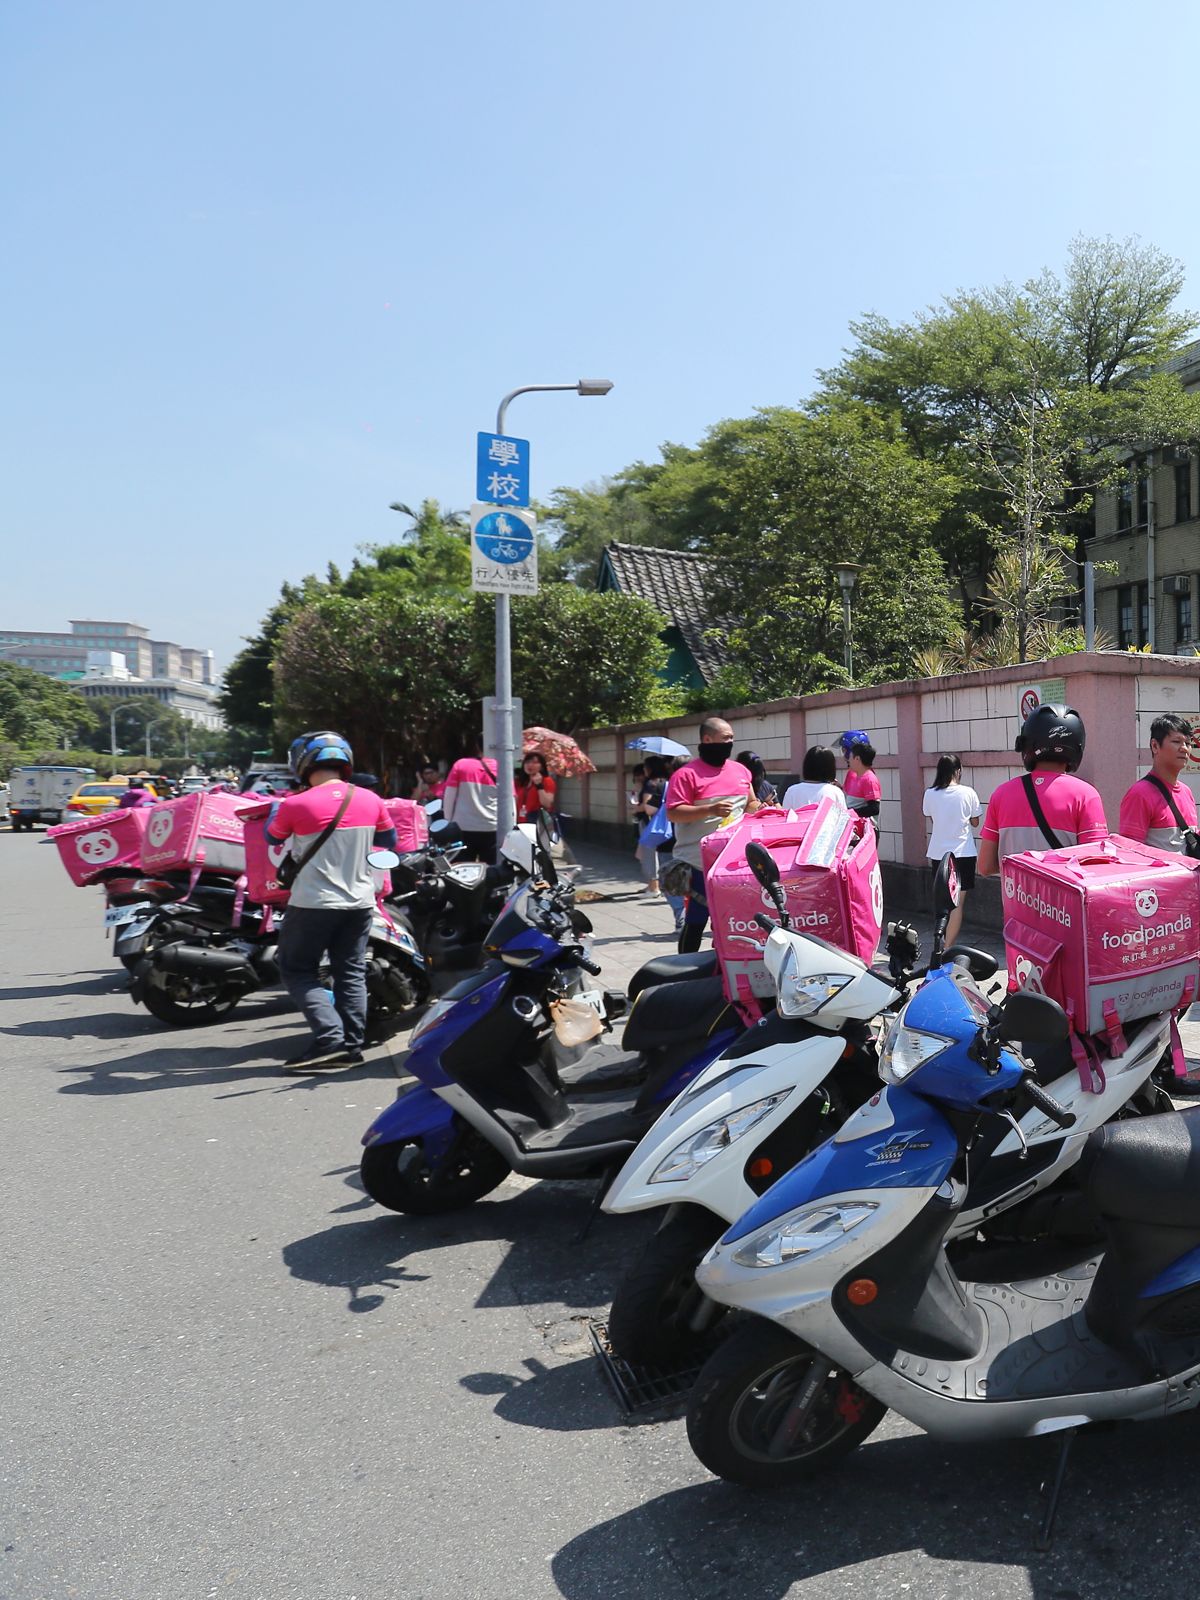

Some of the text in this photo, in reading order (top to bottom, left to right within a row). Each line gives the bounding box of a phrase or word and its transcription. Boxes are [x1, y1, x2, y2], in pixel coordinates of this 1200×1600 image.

[487, 438, 520, 501] 學校
[728, 910, 829, 933] fooanda
[1016, 884, 1072, 928] foodpanda
[1101, 914, 1192, 950] foodpanda
